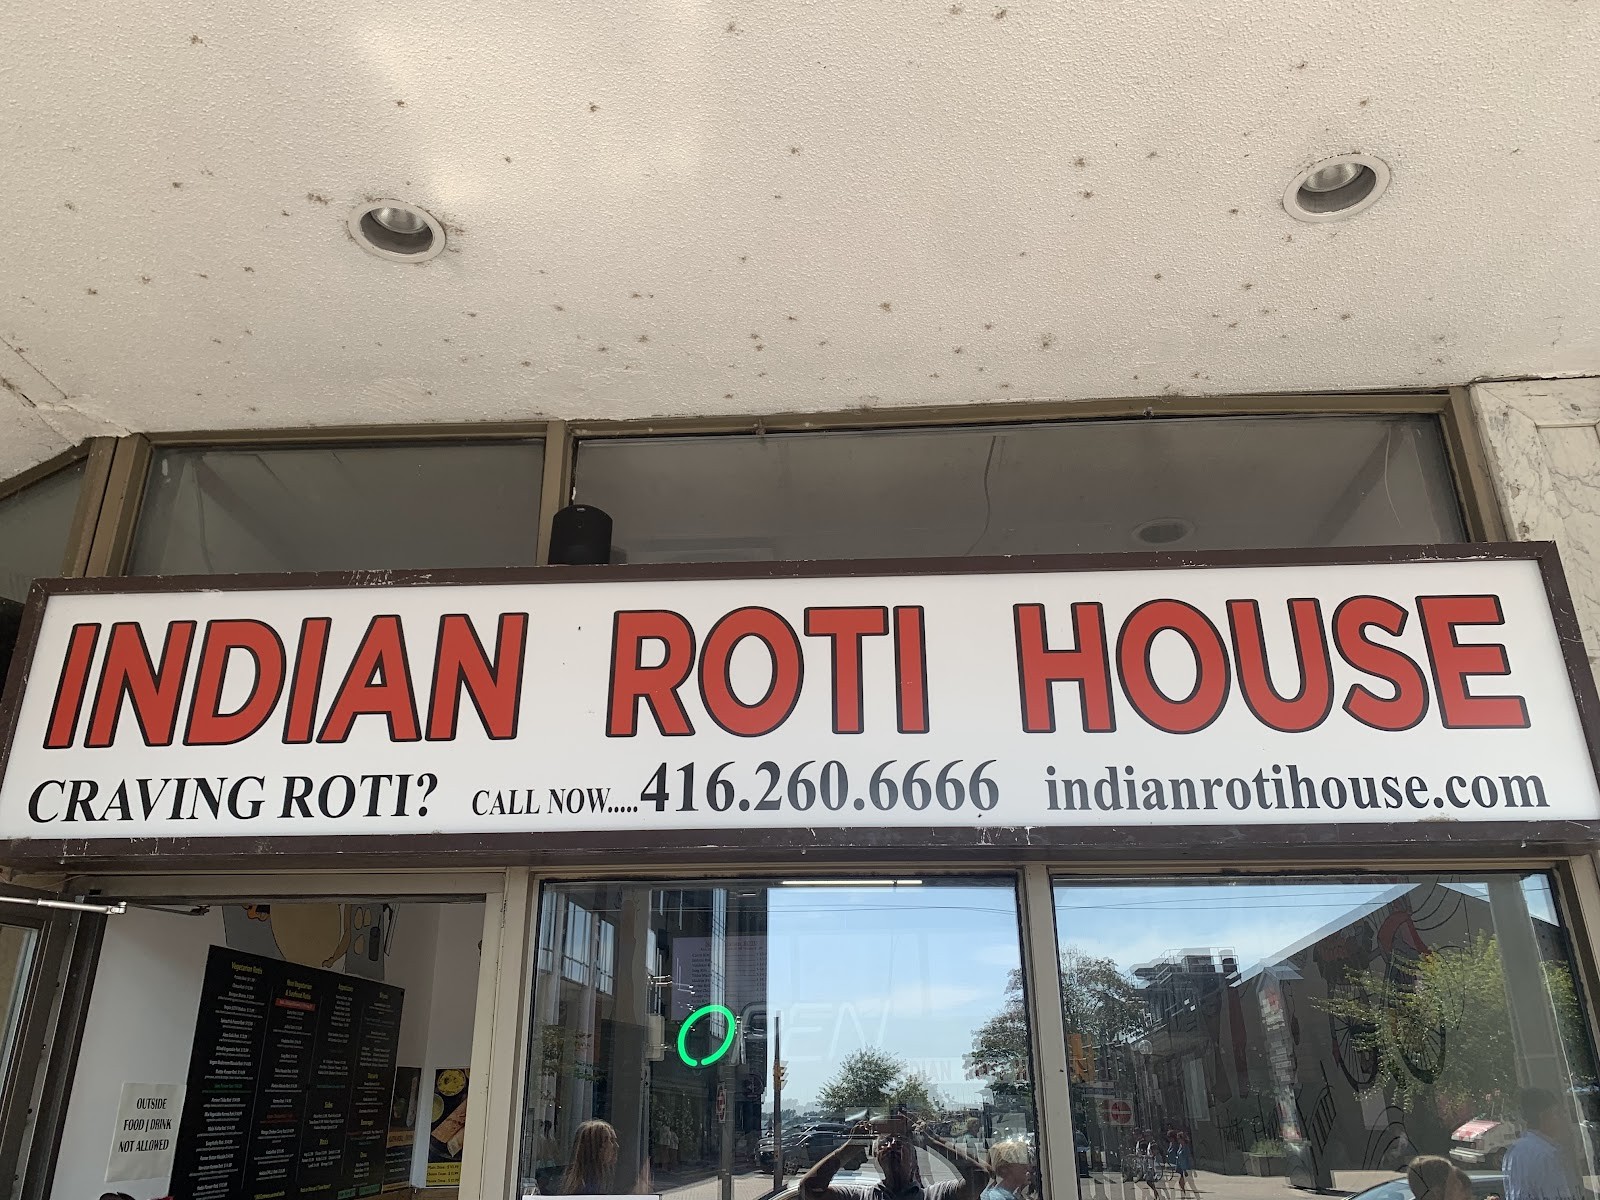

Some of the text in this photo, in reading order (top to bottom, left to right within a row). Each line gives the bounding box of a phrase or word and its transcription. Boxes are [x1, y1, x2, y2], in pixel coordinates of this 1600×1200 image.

[43, 593, 1532, 750] INDIAN ROTI HOUSE
[29, 773, 438, 824] CRAVING ROTI?
[472, 789, 540, 816] CALL
[640, 760, 998, 812] 416.260.6666
[1046, 764, 1549, 811] indianrotihouse.com
[123, 1119, 145, 1131] FOOD
[150, 1118, 172, 1130] DRINK
[136, 1097, 167, 1110] OUTSIDE
[118, 1139, 169, 1152] NOT ALLOWED
